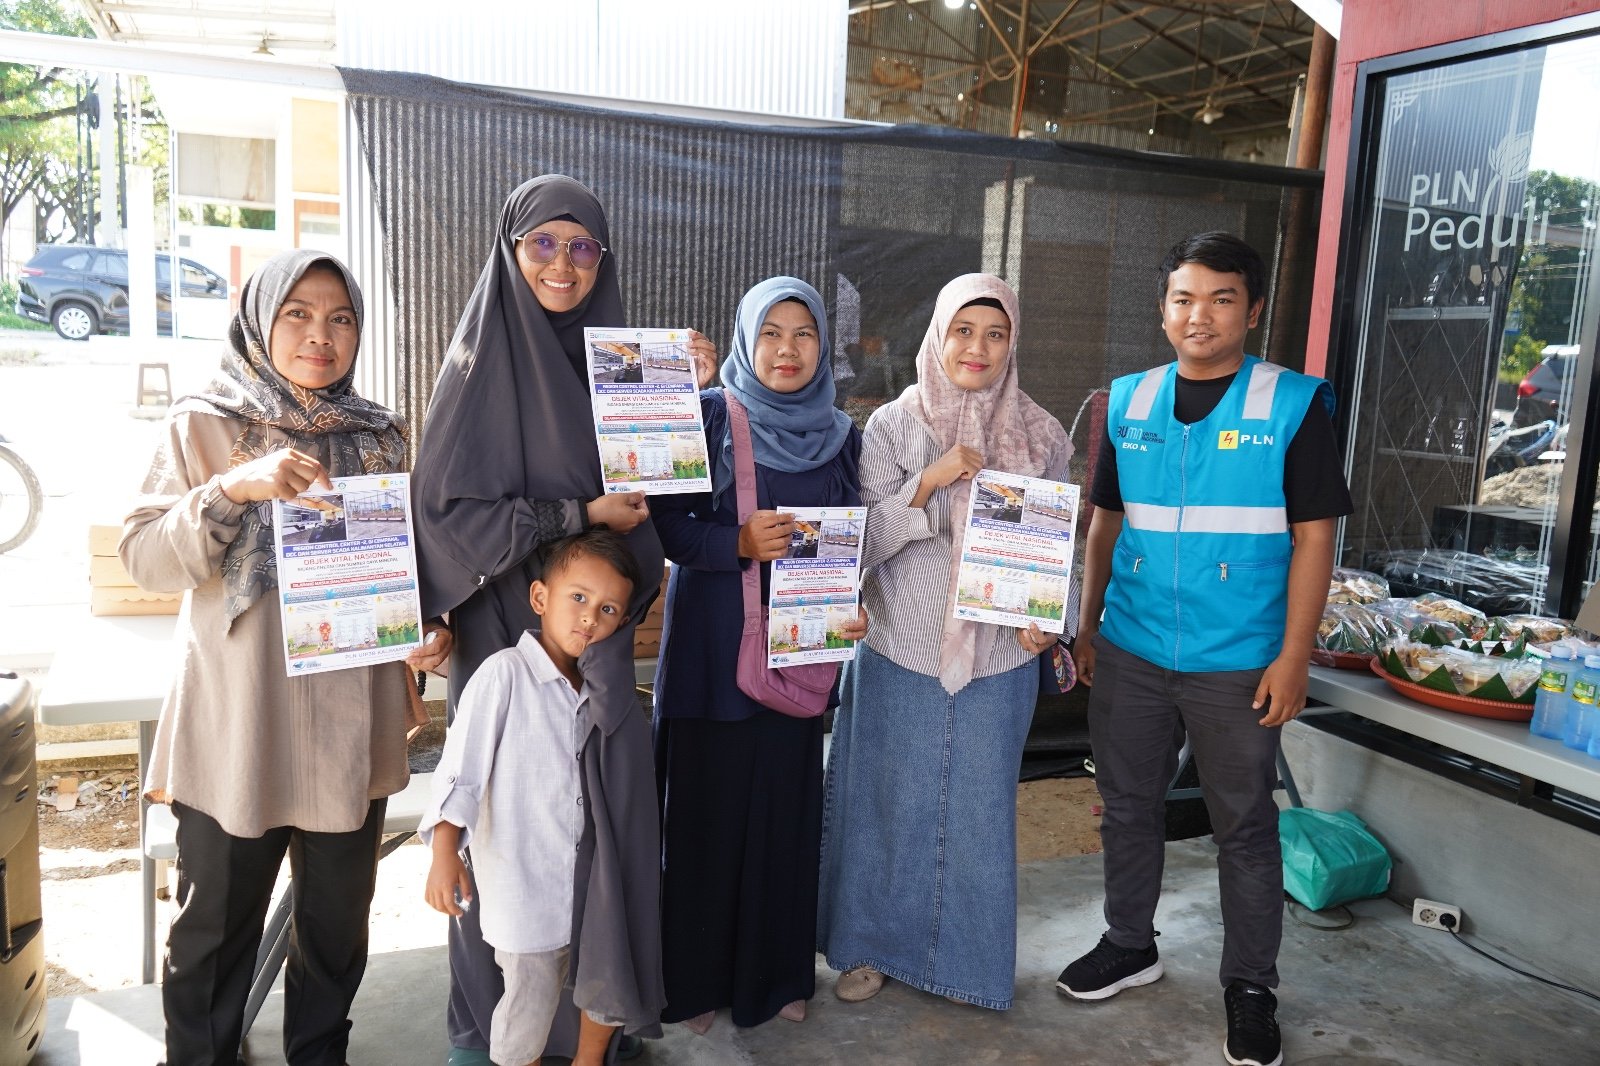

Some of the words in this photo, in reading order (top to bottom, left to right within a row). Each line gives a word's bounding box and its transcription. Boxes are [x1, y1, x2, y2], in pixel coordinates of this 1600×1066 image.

[1409, 168, 1479, 207] PLN
[1404, 196, 1551, 252] Peduli
[1240, 434, 1274, 446] PLN
[303, 557, 329, 566] OBJEK
[330, 555, 351, 563] VITAL
[354, 551, 392, 560] NASIONAL
